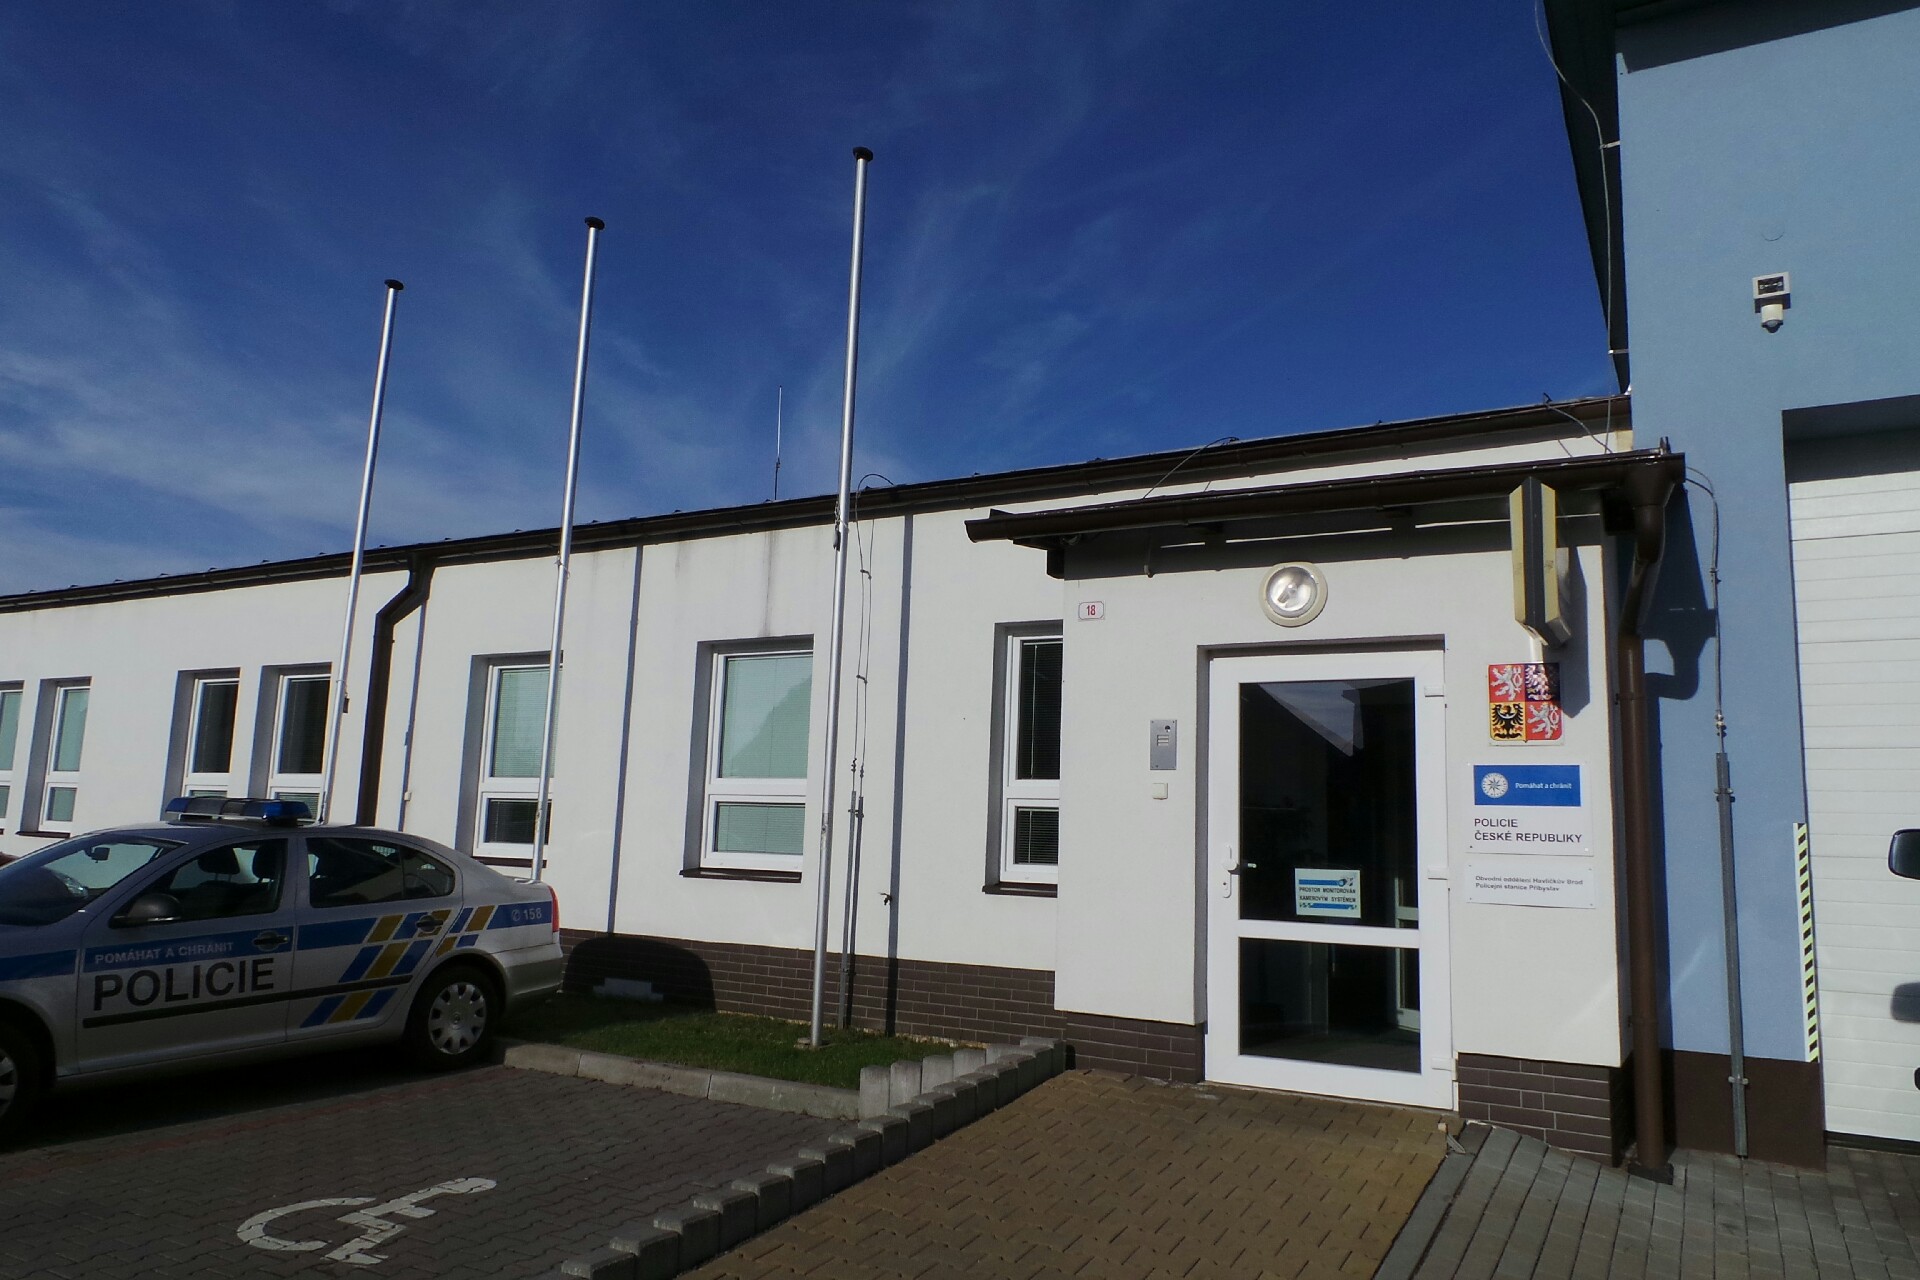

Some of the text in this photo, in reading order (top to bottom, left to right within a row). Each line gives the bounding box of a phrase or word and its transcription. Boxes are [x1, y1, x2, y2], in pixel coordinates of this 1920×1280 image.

[1086, 604, 1096, 616] 18
[1474, 818, 1518, 828] POLICIE
[1474, 829, 1582, 843] ČESKÉ REPUBLIKY
[523, 907, 542, 920] 158
[94, 948, 162, 965] POMÁHAT
[165, 947, 175, 958] A
[93, 957, 275, 1012] POLICIE
